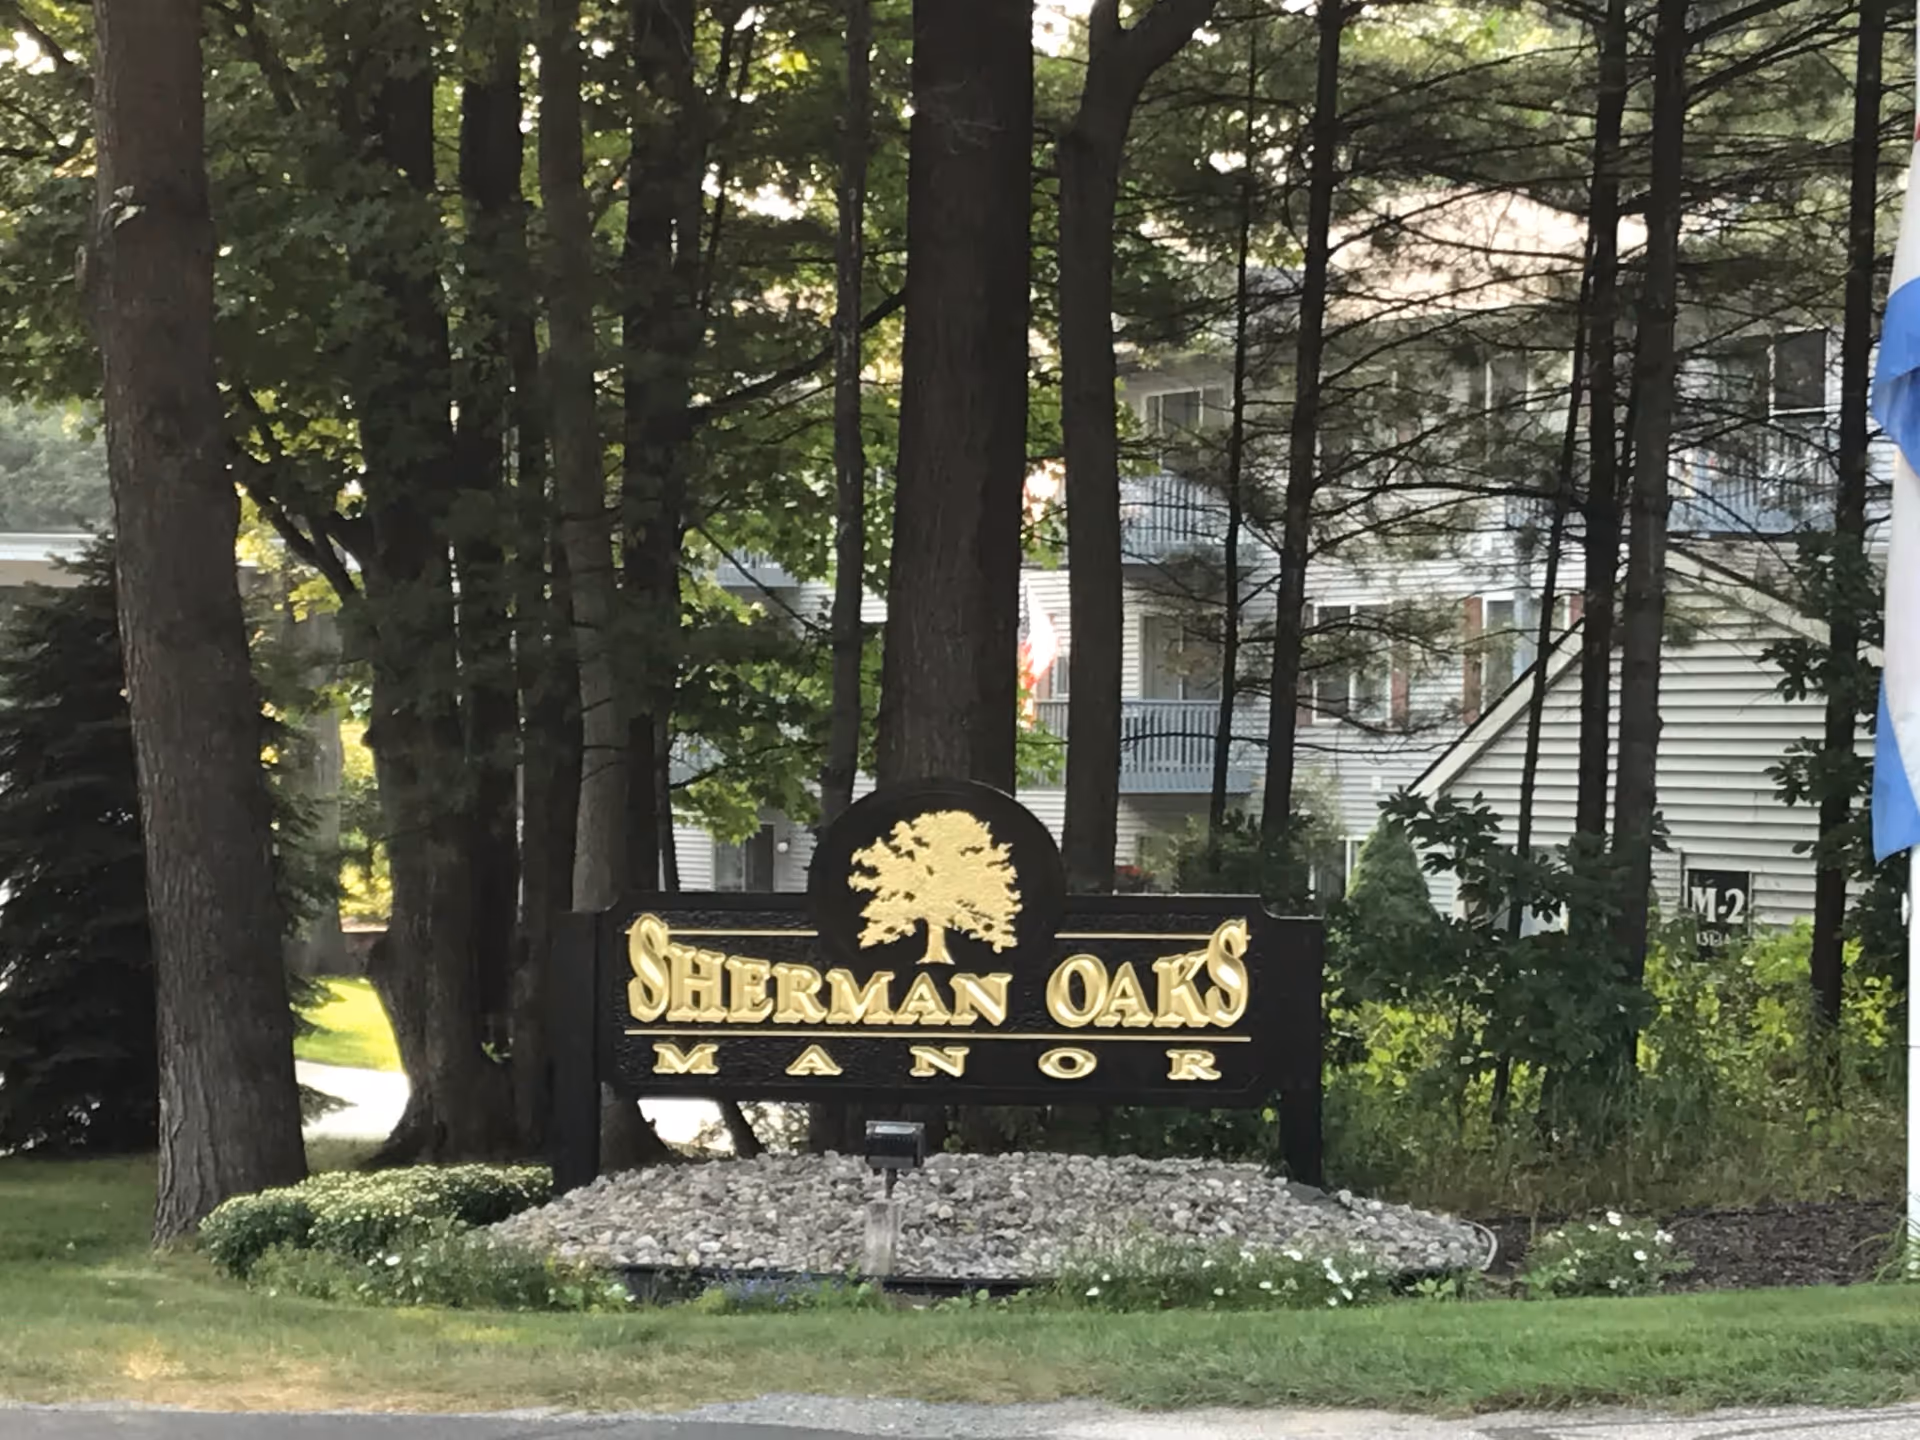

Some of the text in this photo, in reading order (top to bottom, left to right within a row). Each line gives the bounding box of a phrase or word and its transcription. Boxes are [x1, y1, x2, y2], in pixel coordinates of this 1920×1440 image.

[627, 913, 1249, 1028] SHERMAN OAKS
[653, 1043, 1221, 1080] MANOR
